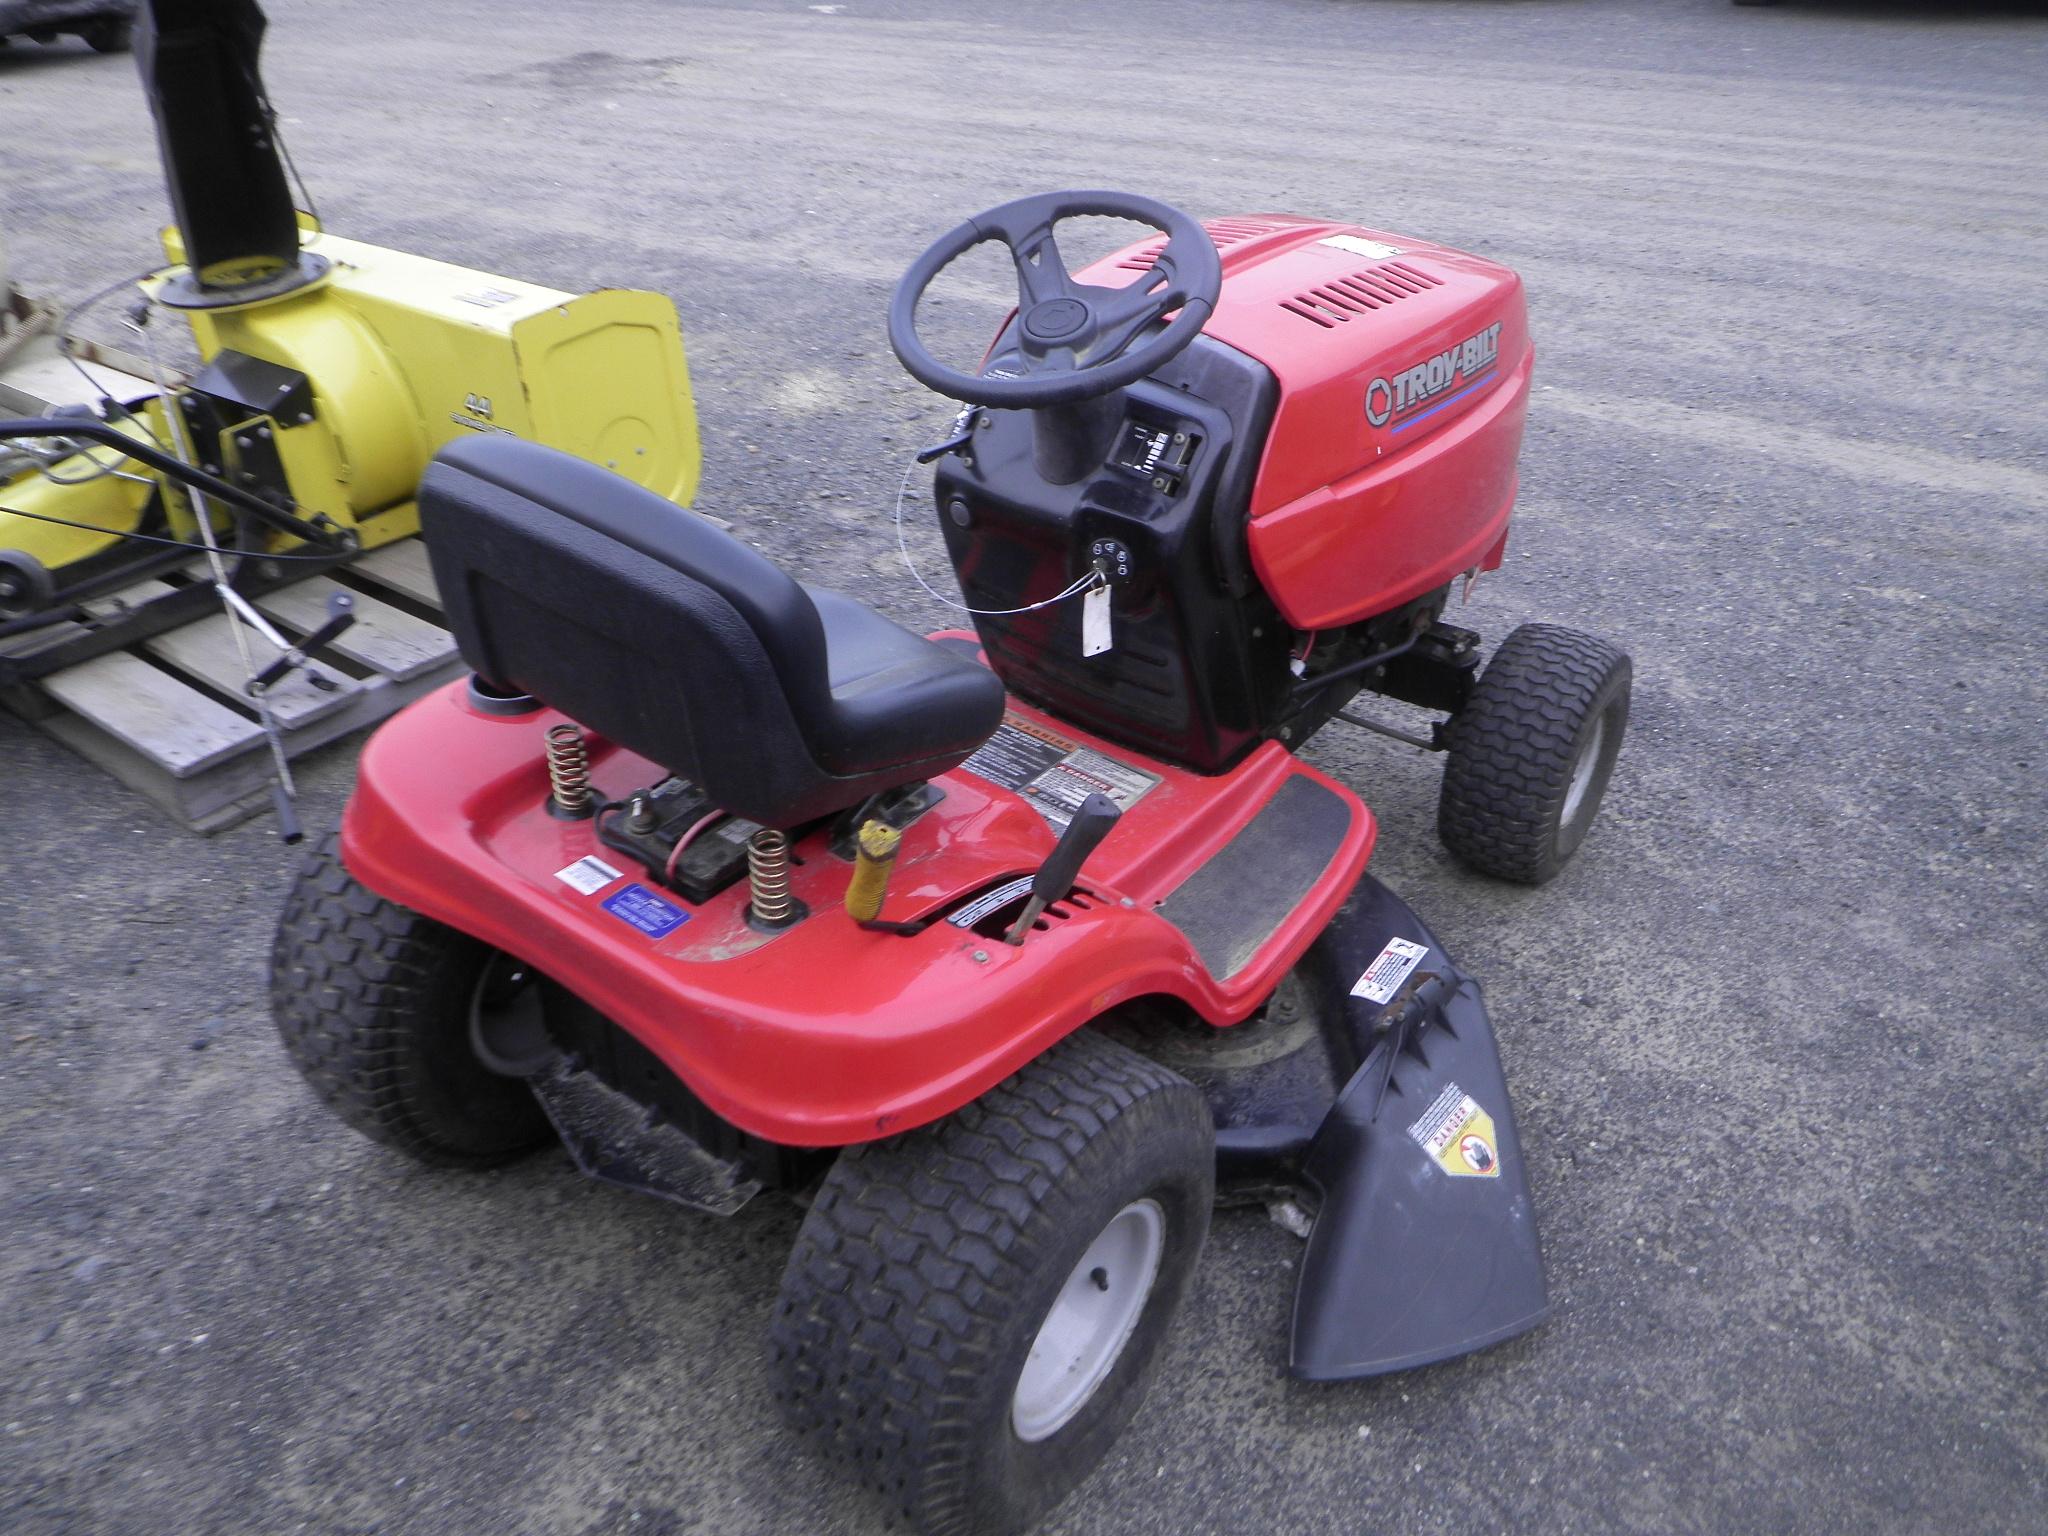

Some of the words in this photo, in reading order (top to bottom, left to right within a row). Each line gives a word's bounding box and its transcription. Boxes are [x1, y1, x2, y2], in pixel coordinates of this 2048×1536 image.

[1392, 321, 1502, 411] TROY-BILT
[1014, 719, 1074, 749] WARNING
[1065, 767, 1110, 791] DANGER
[1433, 1106, 1468, 1148] DANGER
